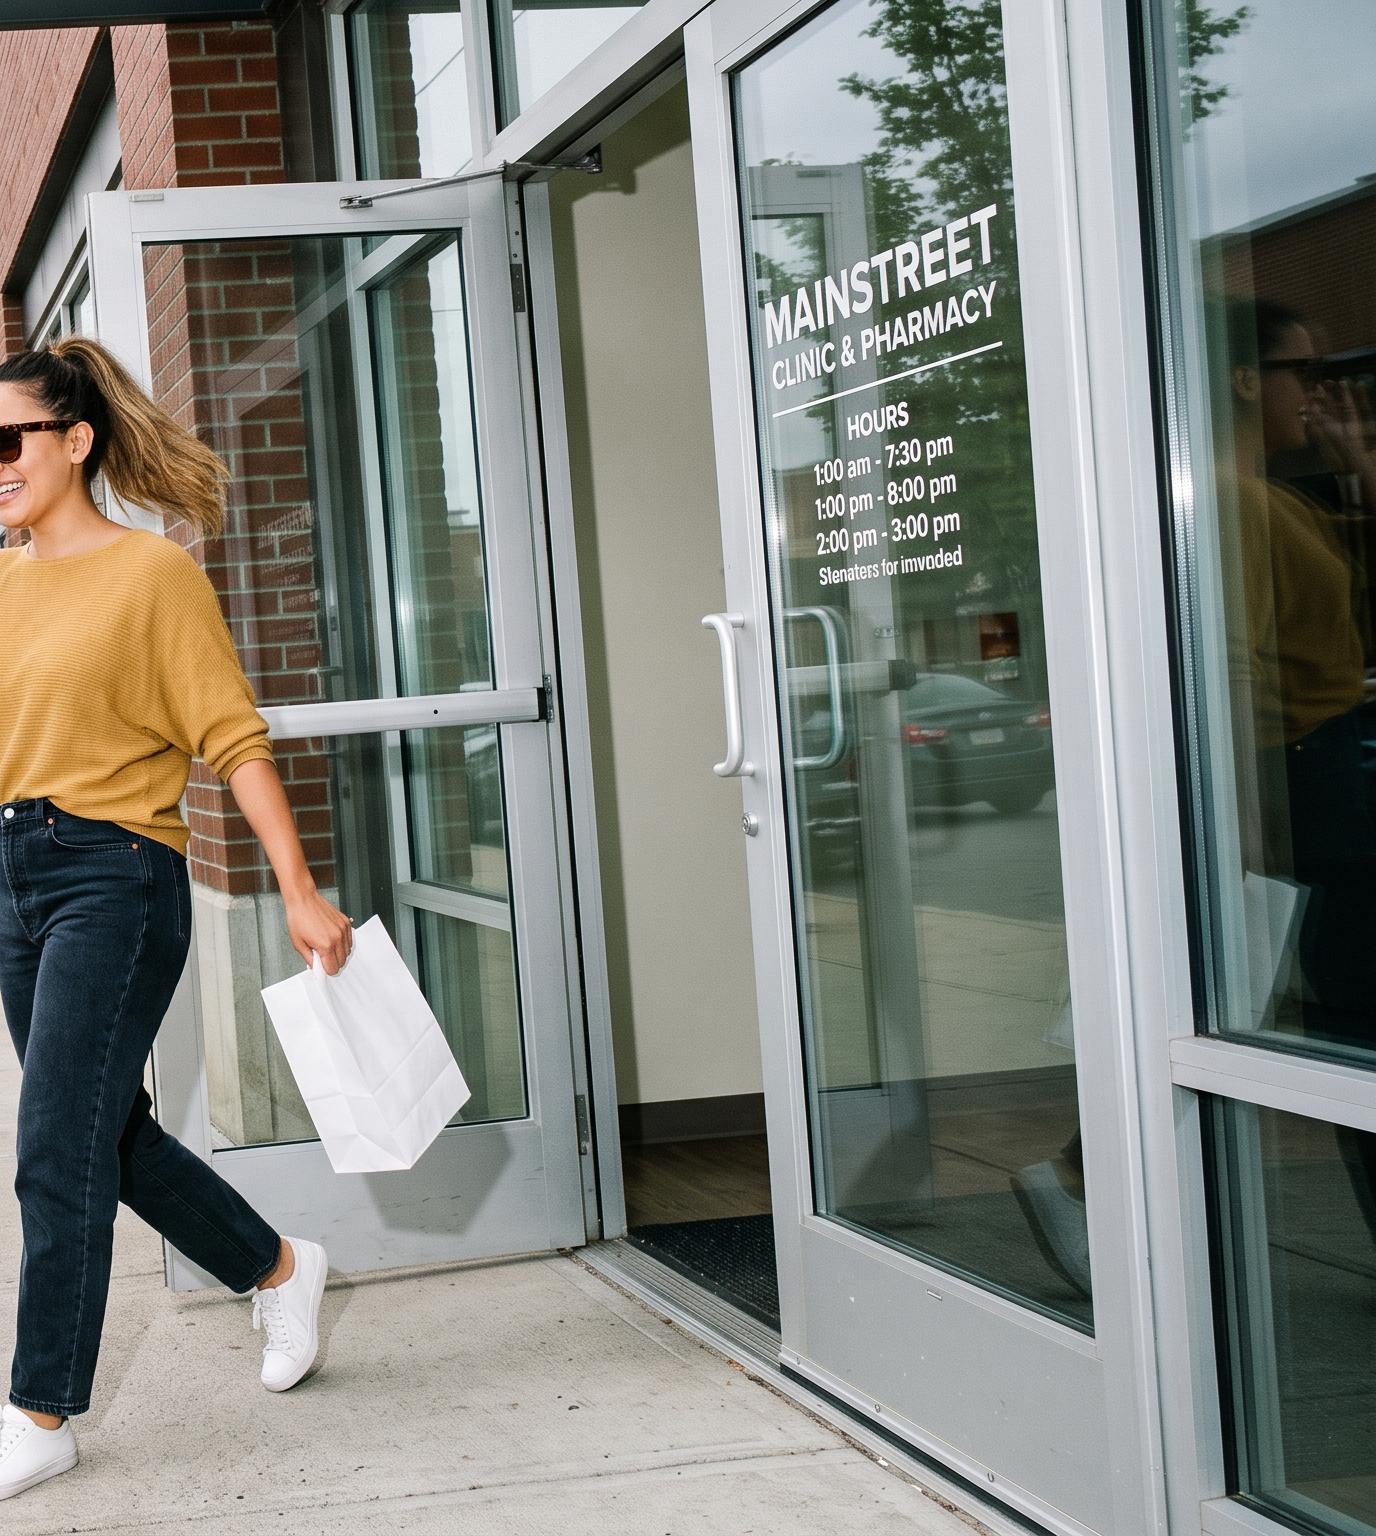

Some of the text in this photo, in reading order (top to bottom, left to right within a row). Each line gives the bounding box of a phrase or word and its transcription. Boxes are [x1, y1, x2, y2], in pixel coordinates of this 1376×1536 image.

[764, 203, 997, 349] MAINSTREET
[772, 281, 997, 390] CLINIC & PHARMACY
[846, 401, 909, 441] HOURS
[813, 458, 844, 486] 1:00
[847, 456, 871, 479] am
[884, 438, 922, 469] 7:30
[925, 435, 953, 466] pm
[814, 493, 845, 520] 1:00
[849, 492, 873, 520] pm
[887, 475, 925, 506] 8:00
[929, 474, 957, 504] pm
[816, 528, 849, 555] 2:00
[853, 528, 878, 555] pm
[891, 512, 928, 542] 3:00
[933, 512, 961, 541] pm
[881, 558, 899, 576] for
